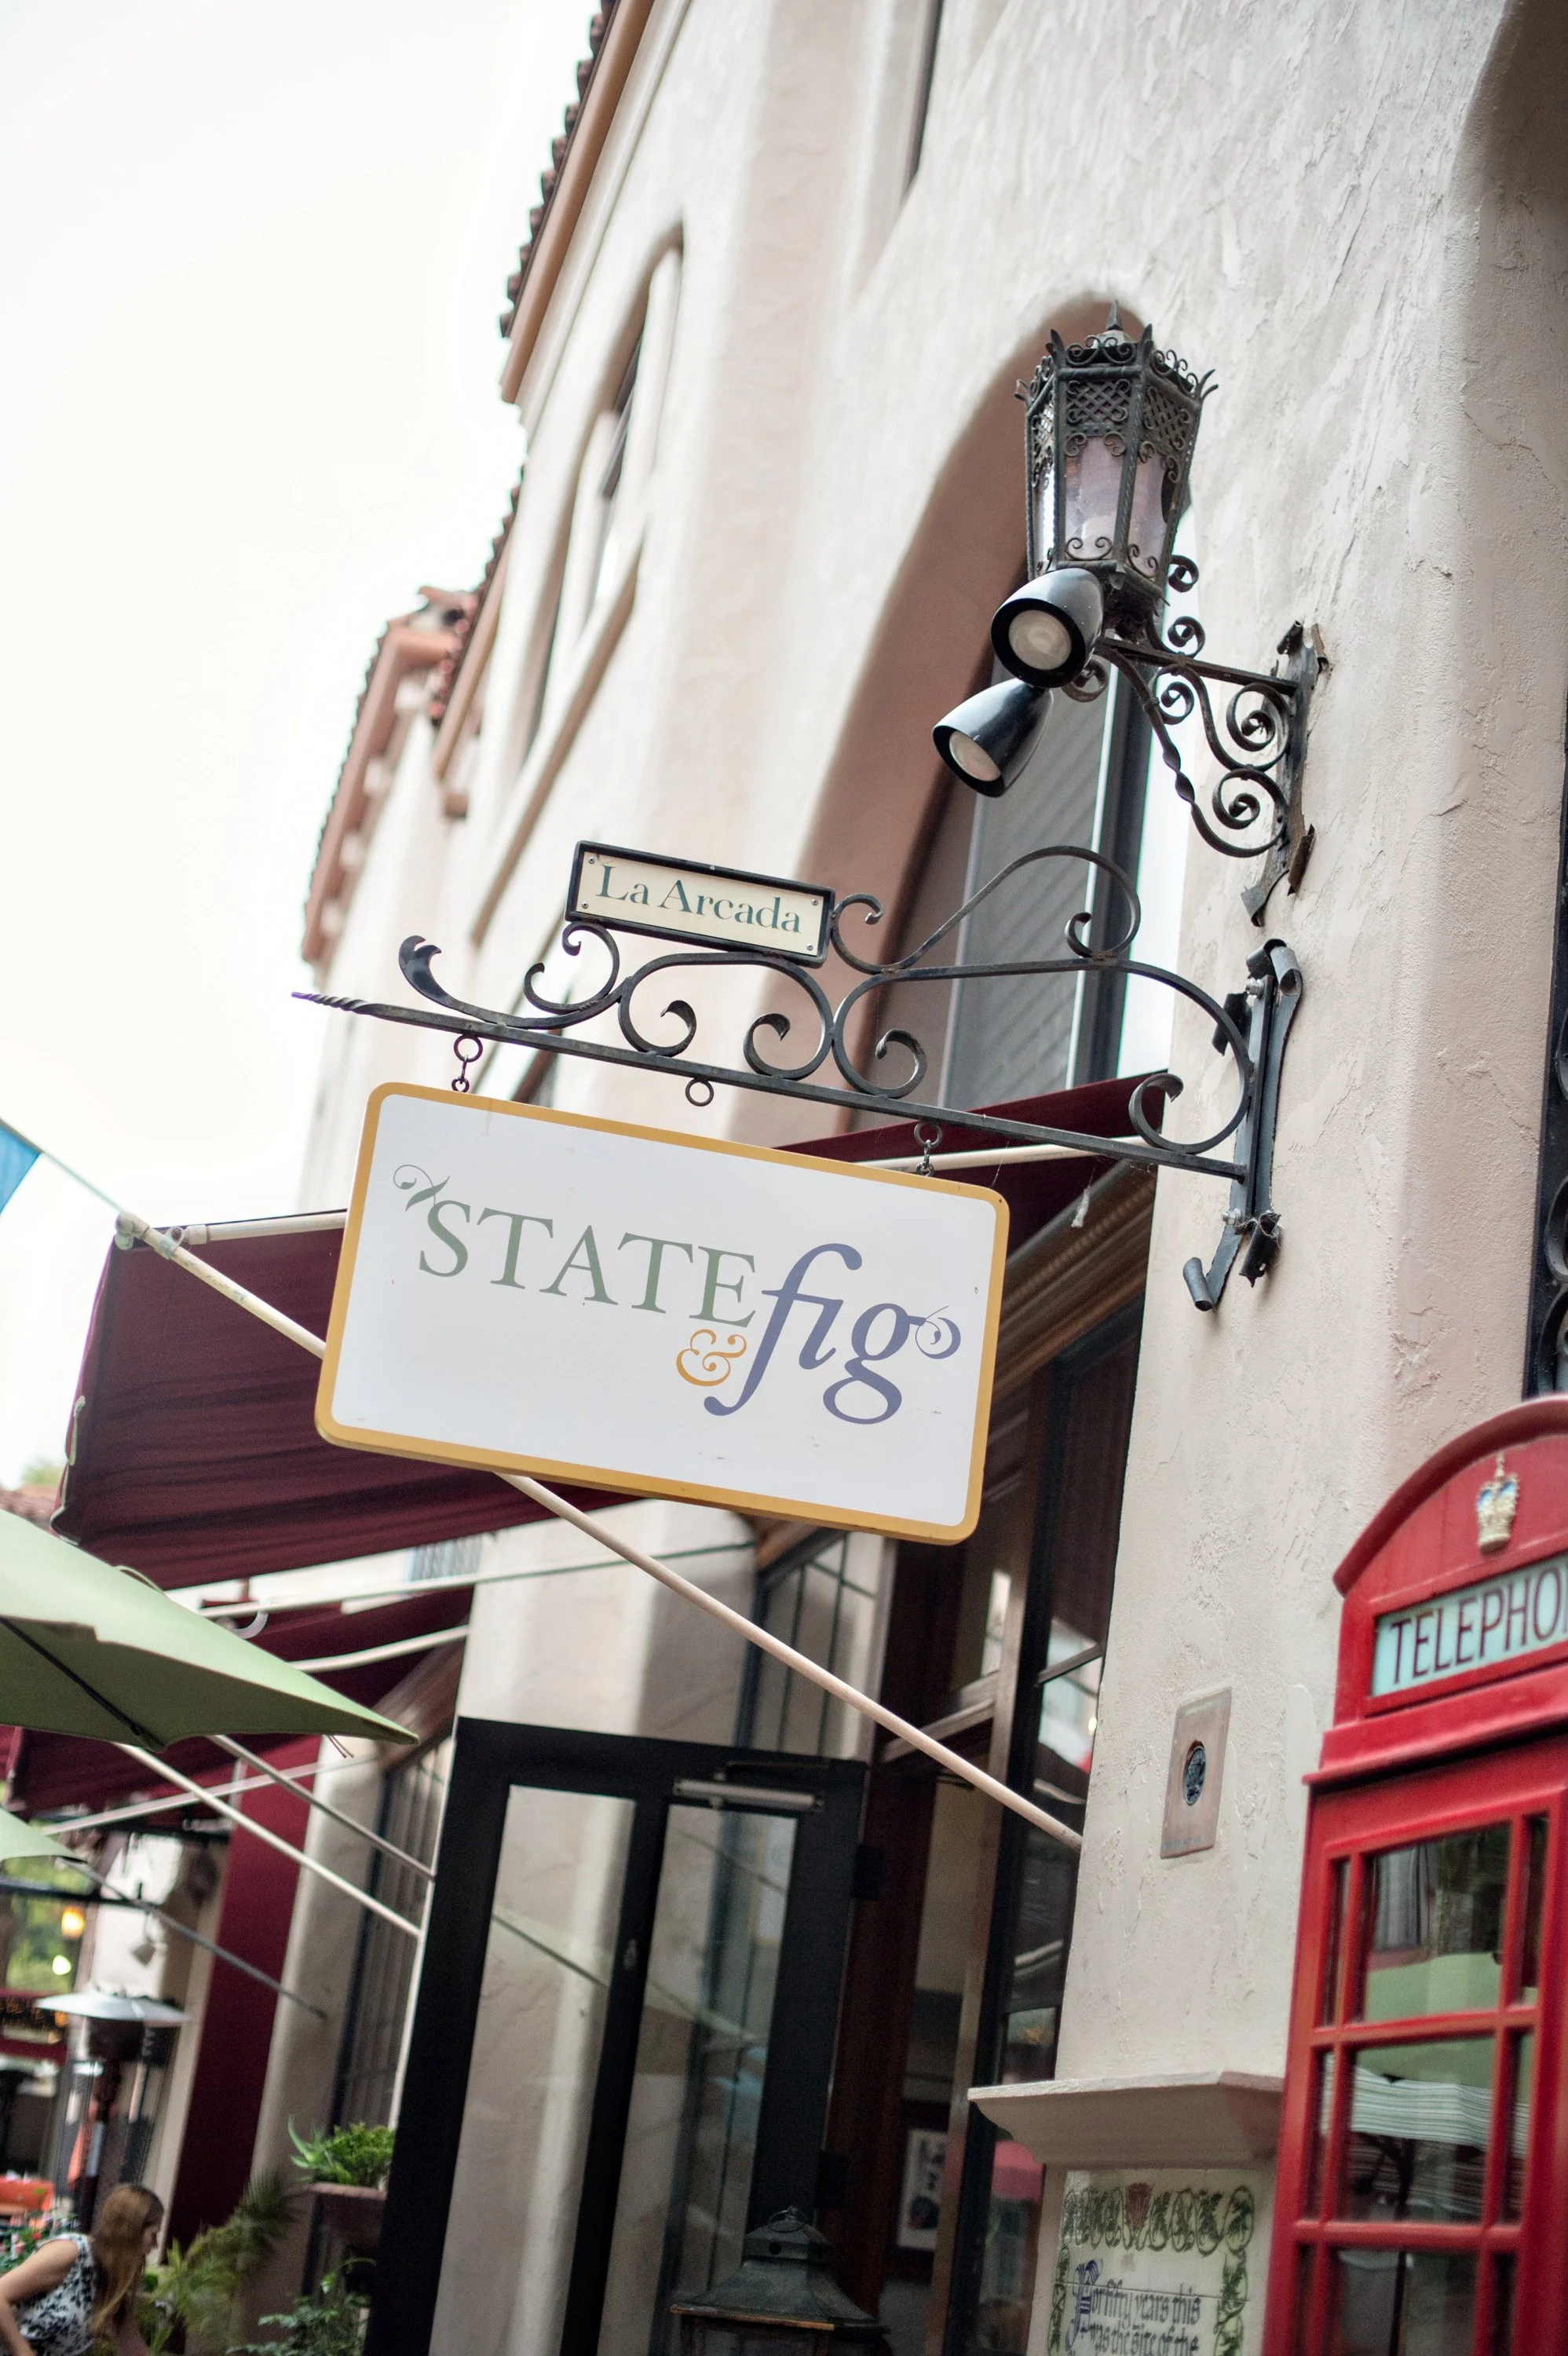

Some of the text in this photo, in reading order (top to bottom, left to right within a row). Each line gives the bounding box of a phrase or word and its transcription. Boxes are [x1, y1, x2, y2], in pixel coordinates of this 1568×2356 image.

[595, 865, 802, 934] La Arcada
[418, 1200, 961, 1425] STATE & fig
[1391, 1568, 1568, 1685] TELEPHO
[1135, 2292, 1169, 2330] years
[1172, 2284, 1201, 2325] this
